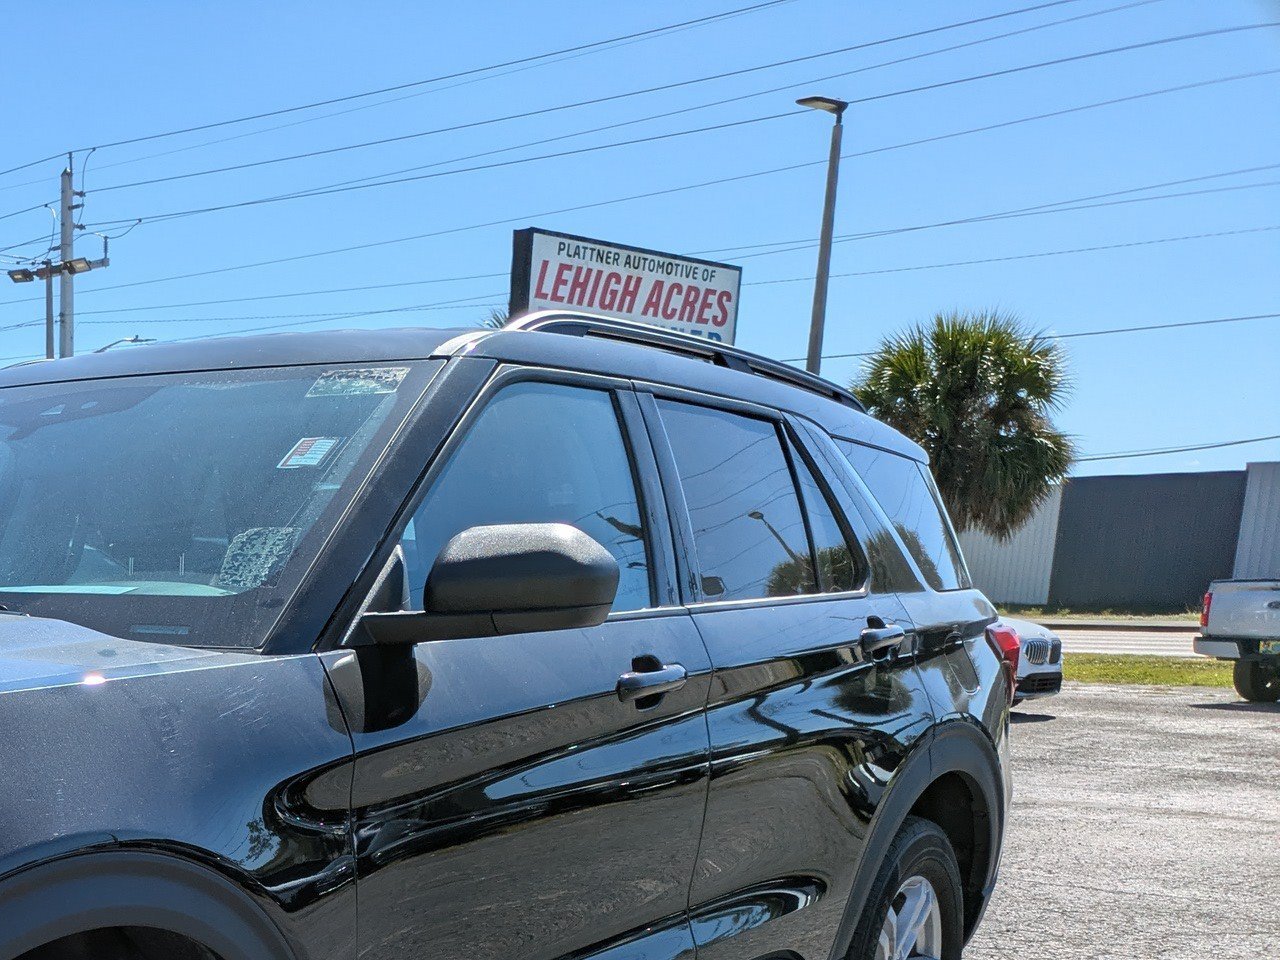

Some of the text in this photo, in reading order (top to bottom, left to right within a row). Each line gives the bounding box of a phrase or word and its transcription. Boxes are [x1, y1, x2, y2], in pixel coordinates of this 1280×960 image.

[557, 241, 717, 283] PLATTNER AUTOMOTIVE OF
[533, 259, 733, 328] LEHIGH ACRES
